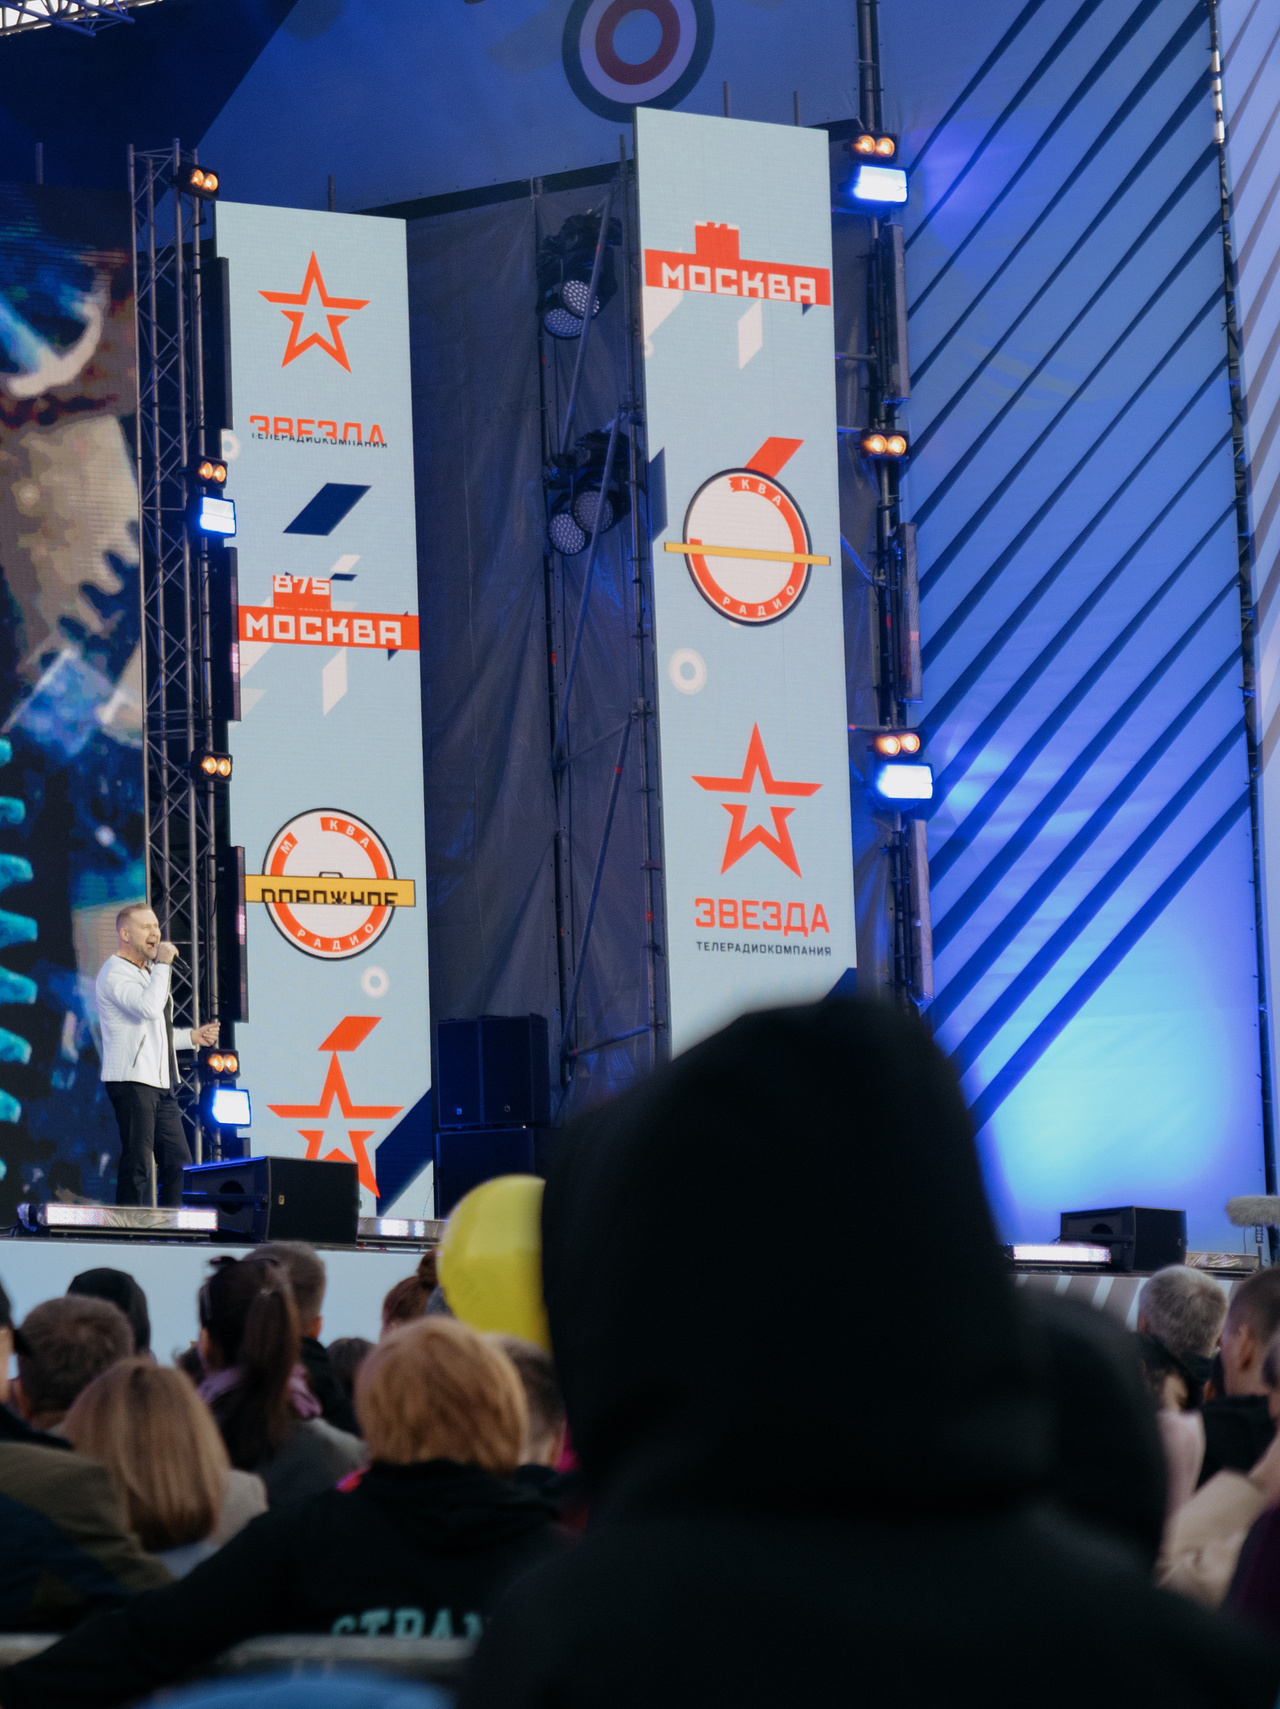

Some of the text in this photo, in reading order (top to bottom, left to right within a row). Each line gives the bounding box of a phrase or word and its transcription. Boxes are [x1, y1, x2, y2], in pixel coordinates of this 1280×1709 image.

[662, 262, 816, 304] МОСКВА
[274, 575, 330, 595] 875
[722, 585, 795, 616] РАДИО
[245, 613, 402, 646] МОСКВА
[694, 897, 830, 938] ЗВЕЗДА
[297, 923, 374, 951] РАДИО
[696, 941, 832, 956] ТЕЛЕРАДИОКОМПАНИЯ
